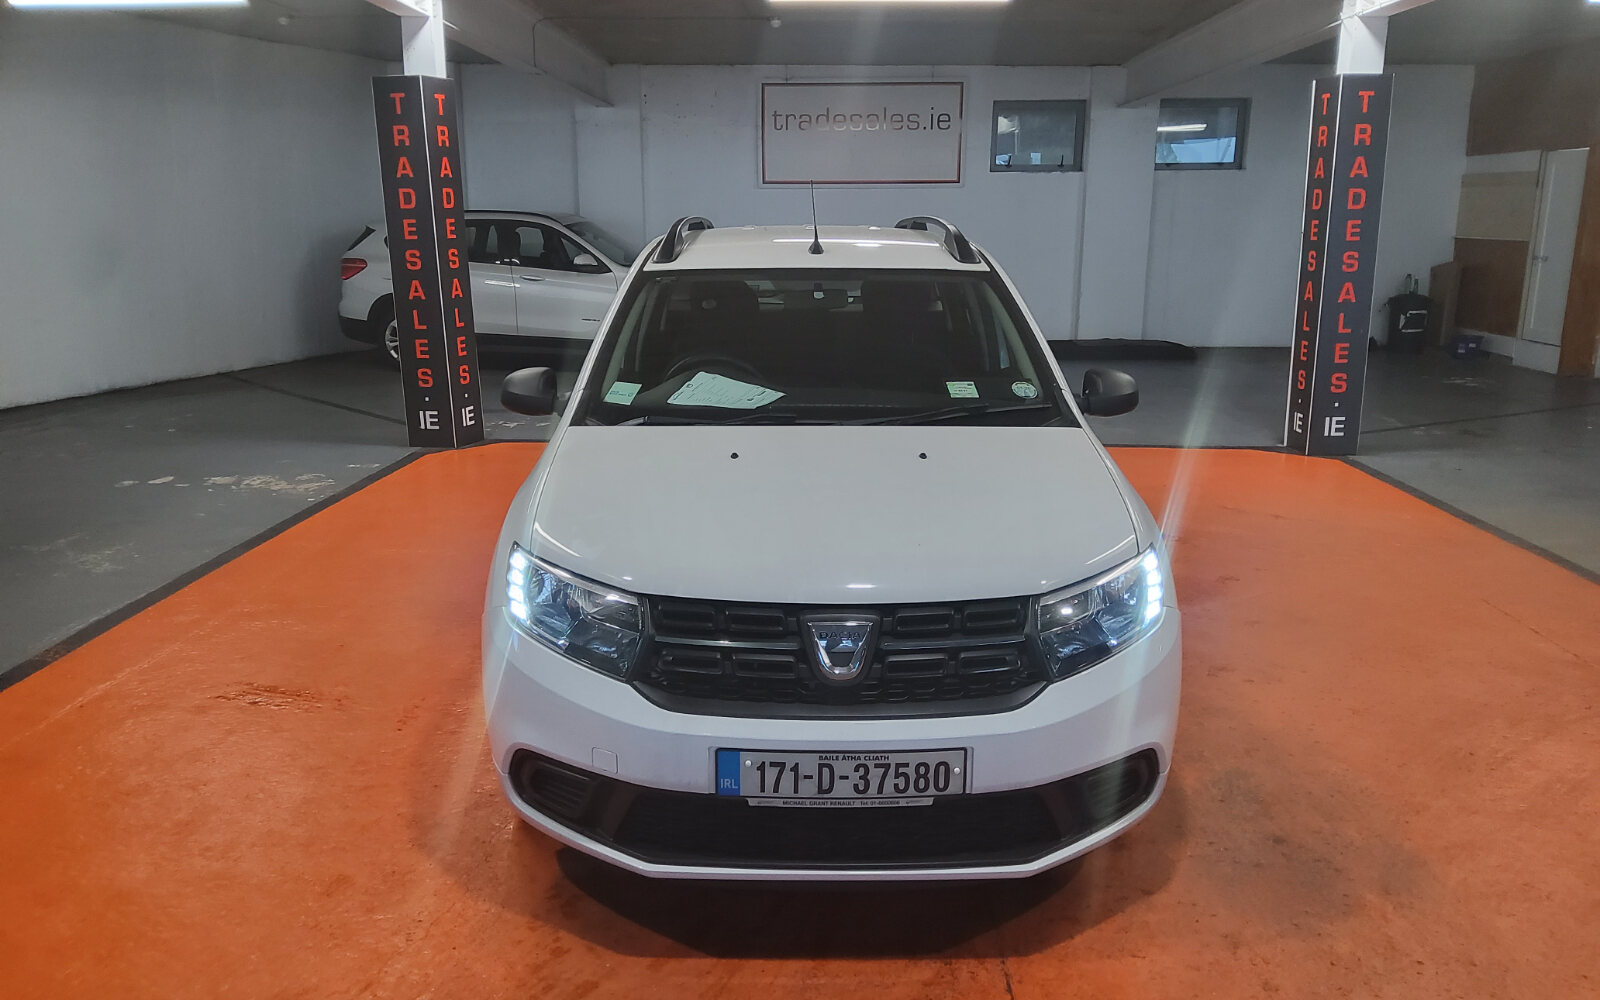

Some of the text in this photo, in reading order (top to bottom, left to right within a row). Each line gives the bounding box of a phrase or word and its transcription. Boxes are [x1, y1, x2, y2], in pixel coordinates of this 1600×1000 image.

[772, 107, 952, 131] tradesales.ie
[820, 631, 860, 639] DACIA
[720, 778, 738, 789] IRL
[755, 761, 950, 795] 171-D-37580
